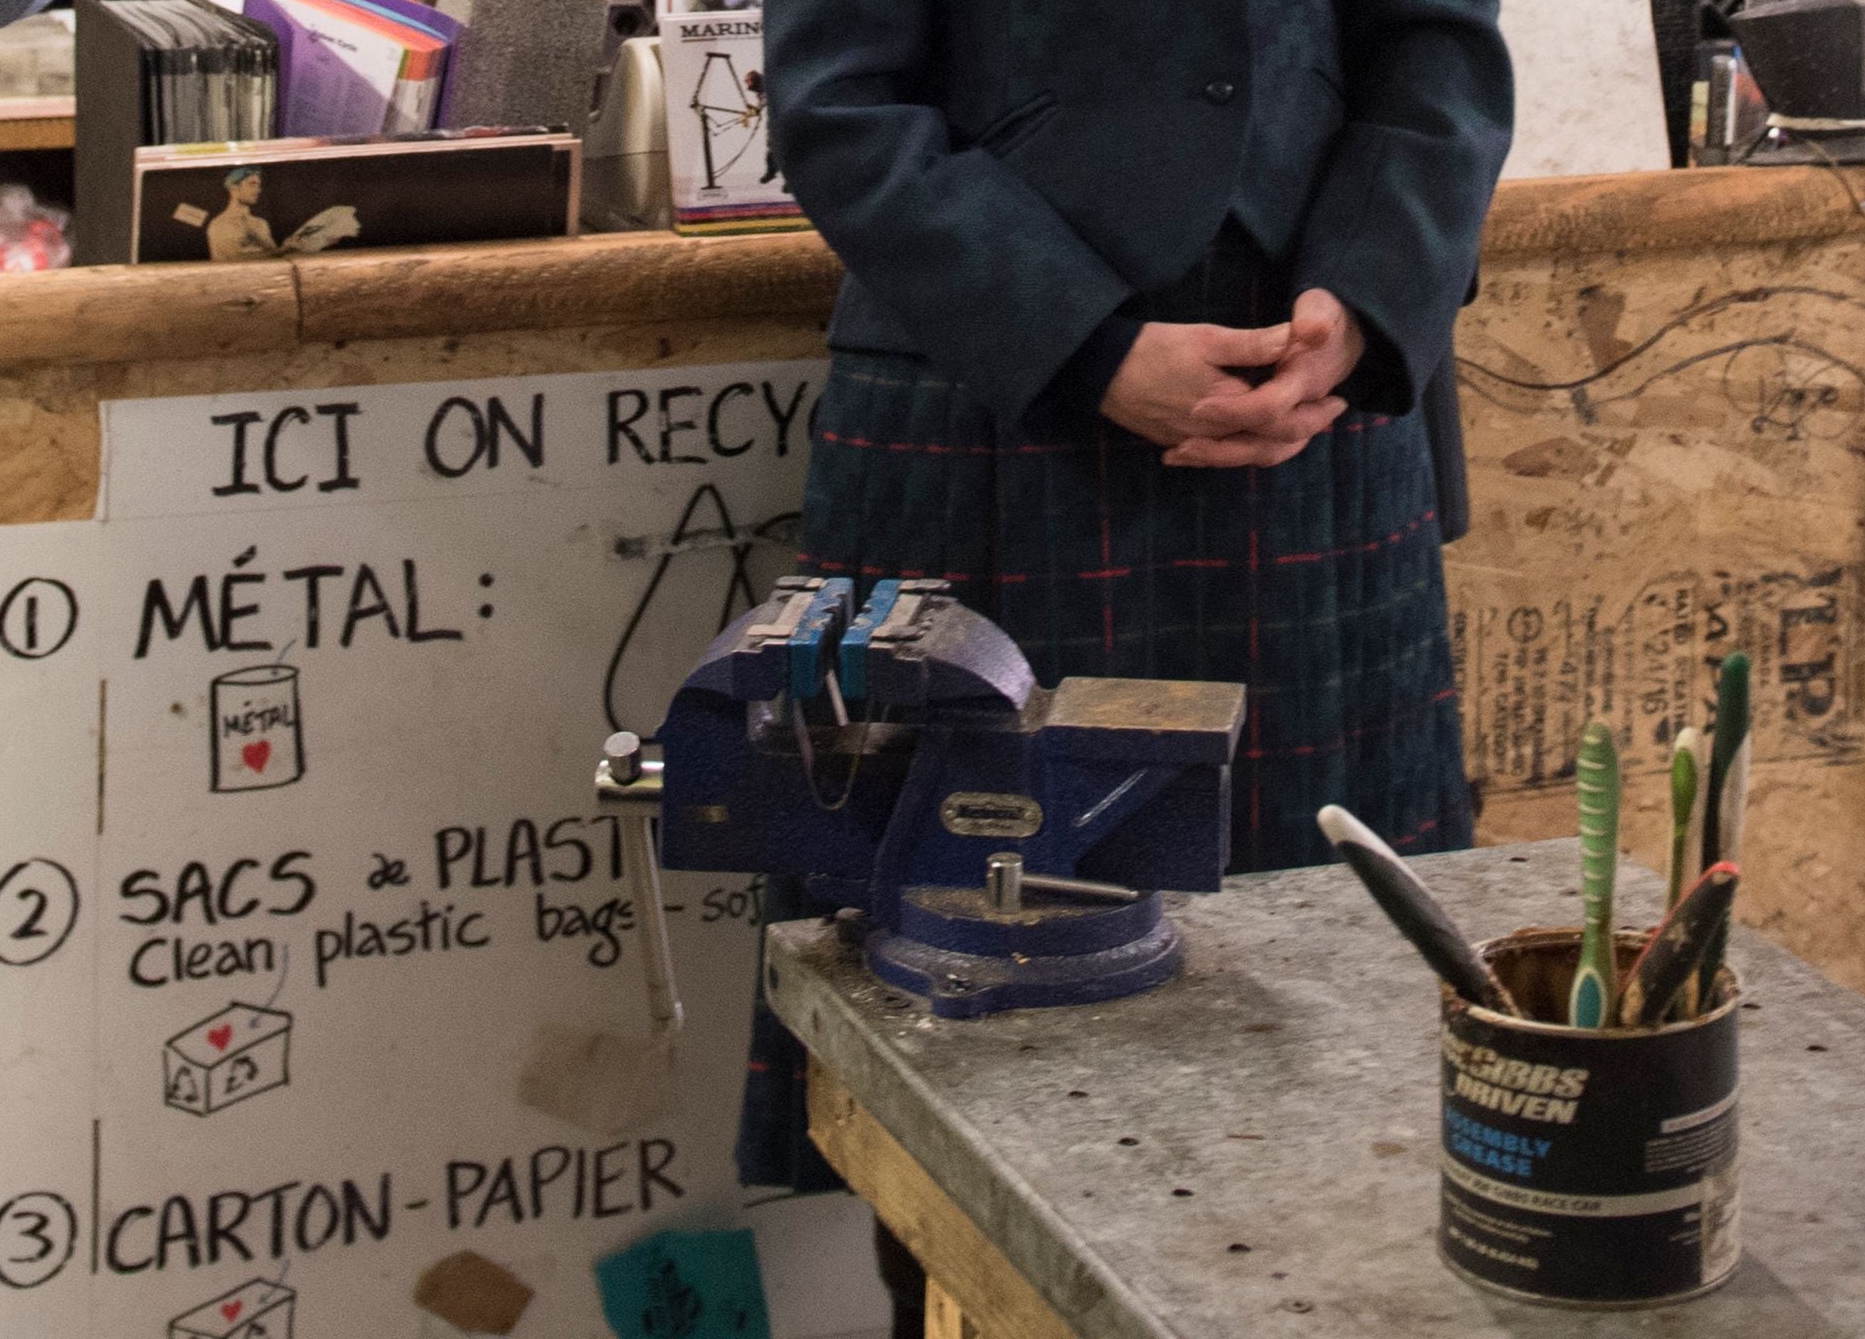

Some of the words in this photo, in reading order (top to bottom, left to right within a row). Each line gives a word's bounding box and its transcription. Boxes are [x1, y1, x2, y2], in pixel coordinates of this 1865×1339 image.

[680, 22, 764, 39] MARIN
[210, 400, 363, 497] ICI
[425, 391, 546, 479] ON
[606, 381, 824, 467] RECY
[223, 701, 293, 738] MÉTAL
[119, 850, 318, 925] SACS
[128, 935, 277, 988] Clean
[316, 904, 491, 988] plastic
[1455, 1073, 1581, 1125] DRIVEN
[106, 1138, 685, 1274] CARTON-PAPIER
